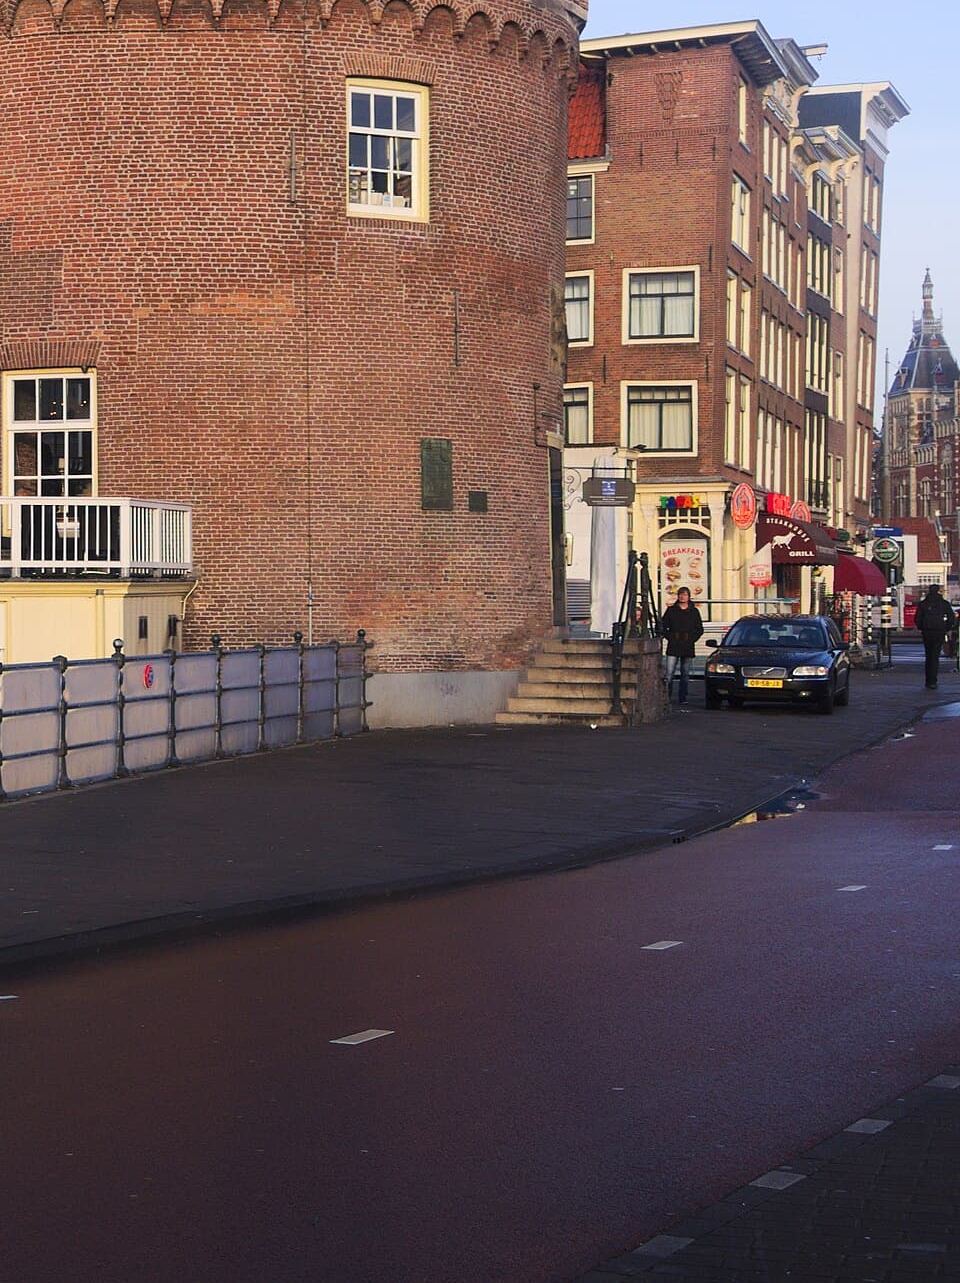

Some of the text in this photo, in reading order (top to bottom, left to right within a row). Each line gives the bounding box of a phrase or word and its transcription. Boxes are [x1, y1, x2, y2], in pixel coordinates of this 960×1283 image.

[660, 495, 700, 509] TAPAS
[766, 517, 811, 542] STEAKHOUSE
[662, 547, 705, 558] BREAKFAST
